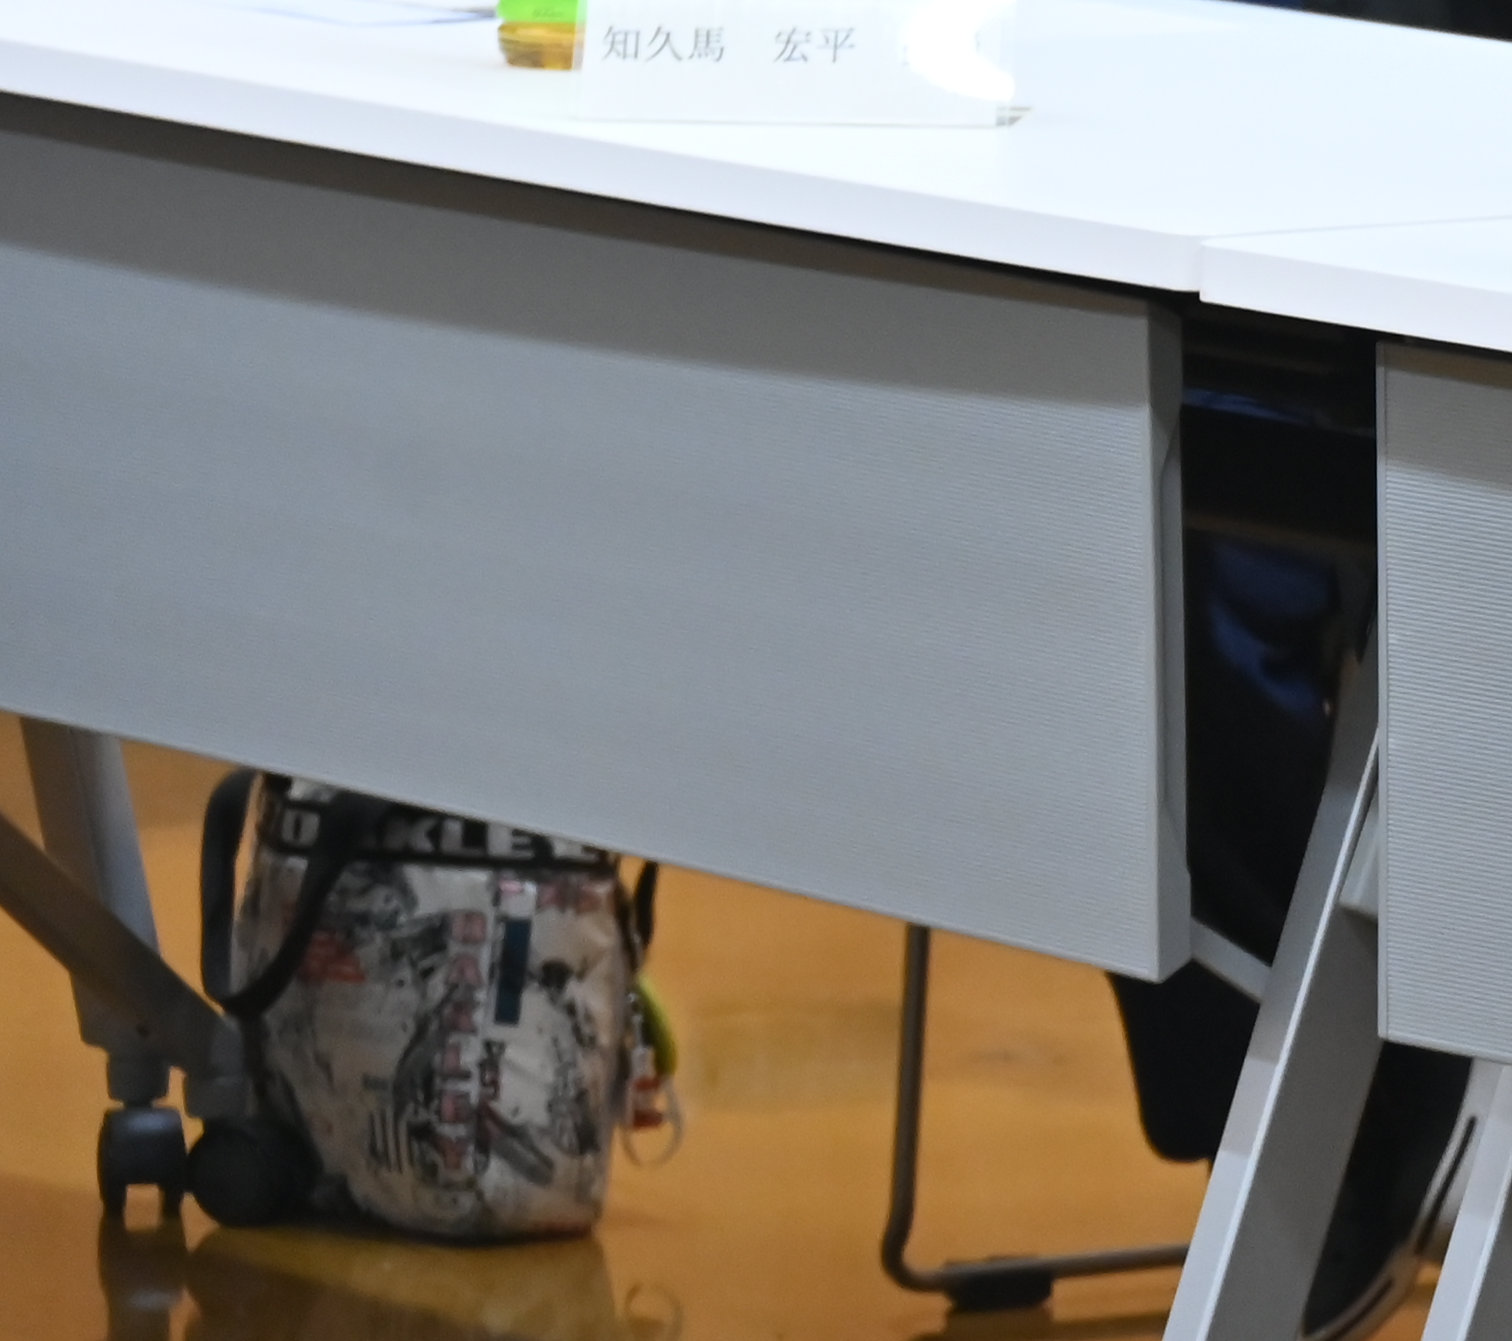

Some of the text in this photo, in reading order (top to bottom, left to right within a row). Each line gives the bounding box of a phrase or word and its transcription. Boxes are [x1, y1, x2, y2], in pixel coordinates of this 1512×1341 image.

[601, 25, 725, 63] 知久馬
[773, 26, 857, 64] 宏平
